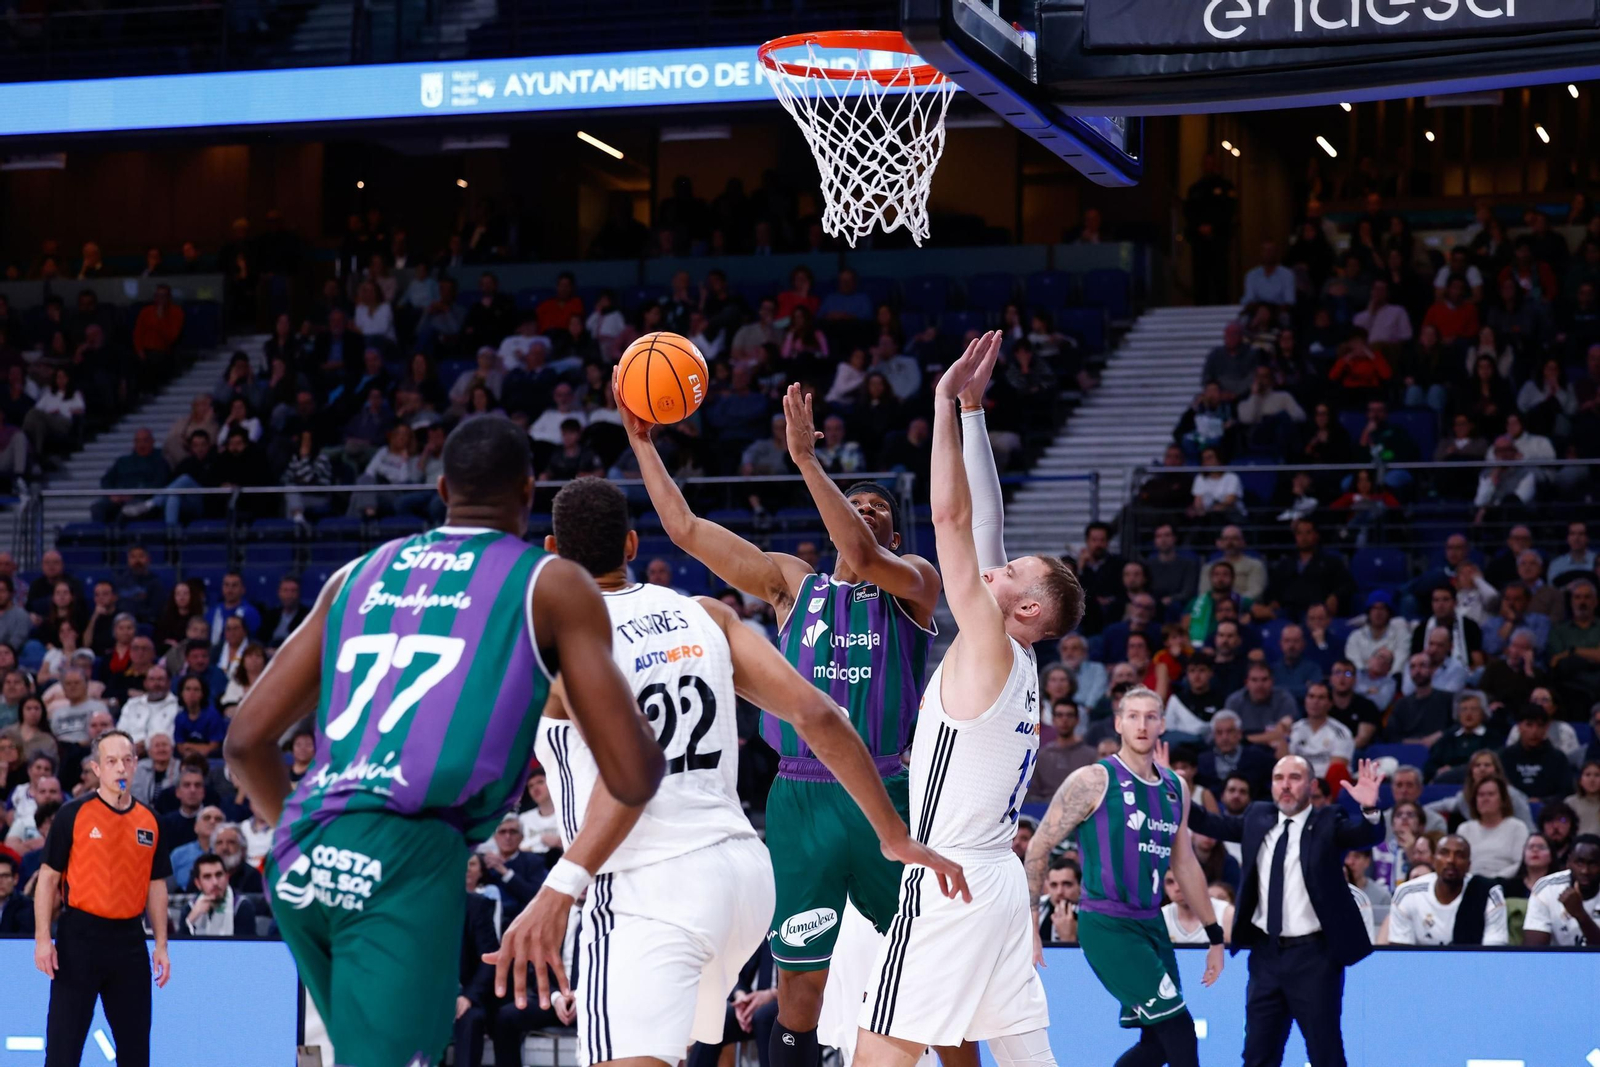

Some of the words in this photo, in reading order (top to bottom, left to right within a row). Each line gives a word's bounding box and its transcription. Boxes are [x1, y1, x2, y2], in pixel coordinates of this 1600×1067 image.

[503, 63, 709, 97] AYUNTAMIENTO
[714, 61, 749, 87] DE
[393, 545, 475, 572] Sima
[830, 630, 880, 650] Unicaja
[635, 644, 703, 673] AUTOHERO
[325, 632, 466, 741] 77
[311, 844, 382, 882] COSTA
[336, 873, 373, 898] SOL
[1152, 868, 1160, 894] 1
